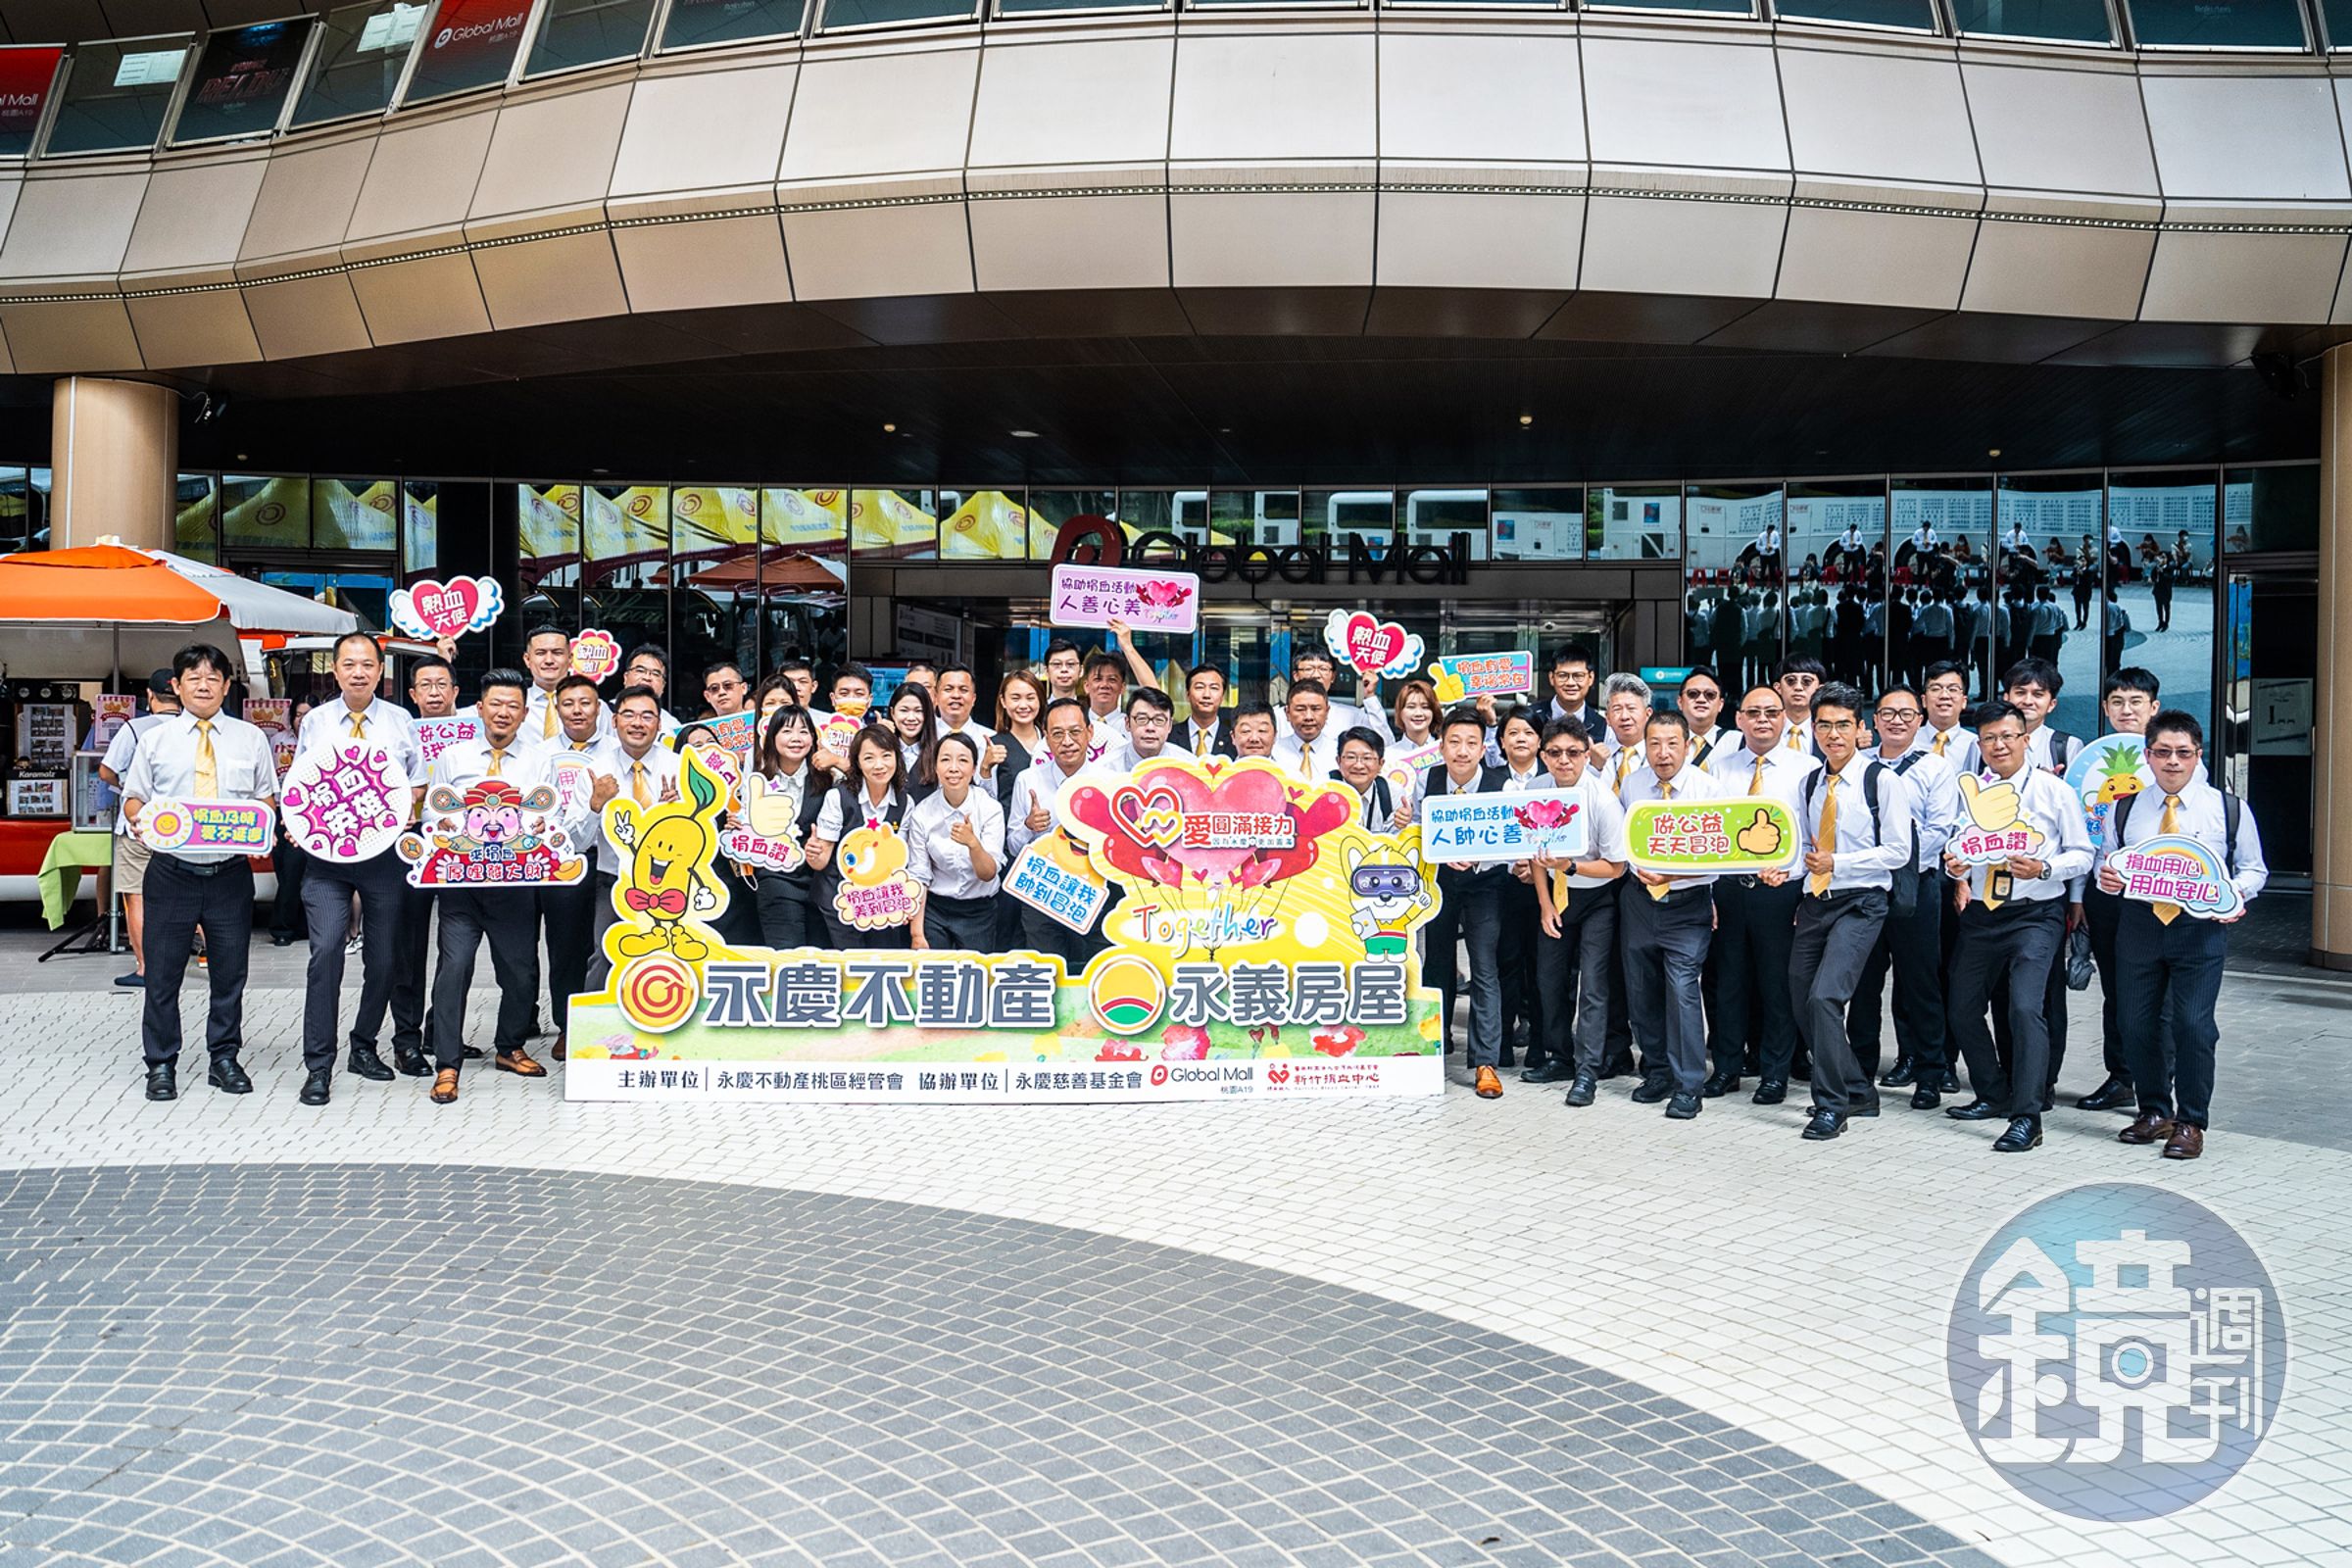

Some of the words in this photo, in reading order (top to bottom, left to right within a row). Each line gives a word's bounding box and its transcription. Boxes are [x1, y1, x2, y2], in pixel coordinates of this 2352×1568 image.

[452, 24, 492, 42] Global
[494, 13, 525, 31] Mall
[10, 93, 39, 107] Mall
[1348, 531, 1472, 585] Mall
[1060, 576, 1137, 595] 協助捐血活動
[420, 589, 466, 615] 熱血
[1059, 595, 1142, 616] 人善心美
[432, 608, 469, 631] 天使
[1350, 624, 1392, 651] 熱血
[1353, 645, 1389, 666] 天使
[310, 763, 368, 809] 捐血
[320, 787, 387, 841] 英雄
[1431, 805, 1514, 823] 協助捐血活動
[1653, 812, 1723, 835] 做公益
[1184, 814, 1293, 846] 愛圓滿接力
[1431, 823, 1522, 846] 人帥心善
[731, 834, 791, 863] 捐血讚
[1647, 834, 1731, 857] 天天冒泡
[1960, 832, 2029, 856] 捐血讚
[2125, 852, 2203, 878] 捐血用心
[1026, 855, 1097, 906] 捐血讓我
[2129, 874, 2221, 904] 用血安心
[846, 883, 904, 905] 捐血讓我
[1014, 871, 1088, 924] 帥到冒泡
[855, 897, 911, 918] 美到冒泡
[1133, 903, 1276, 959] Together
[705, 961, 1055, 1026] 永慶不動產
[1169, 964, 1407, 1025] 永義房屋
[616, 1069, 699, 1090] 主辦單位
[716, 1071, 905, 1092] 永慶不動產桃區經管會
[918, 1071, 1000, 1092] 協辦單位
[1014, 1071, 1143, 1092] 永慶慈善基金會
[1170, 1066, 1221, 1084] Global
[1224, 1066, 1253, 1082] Mall
[1294, 1072, 1381, 1086] 新竹捐血中心
[1219, 1085, 1254, 1095] 桃園A19
